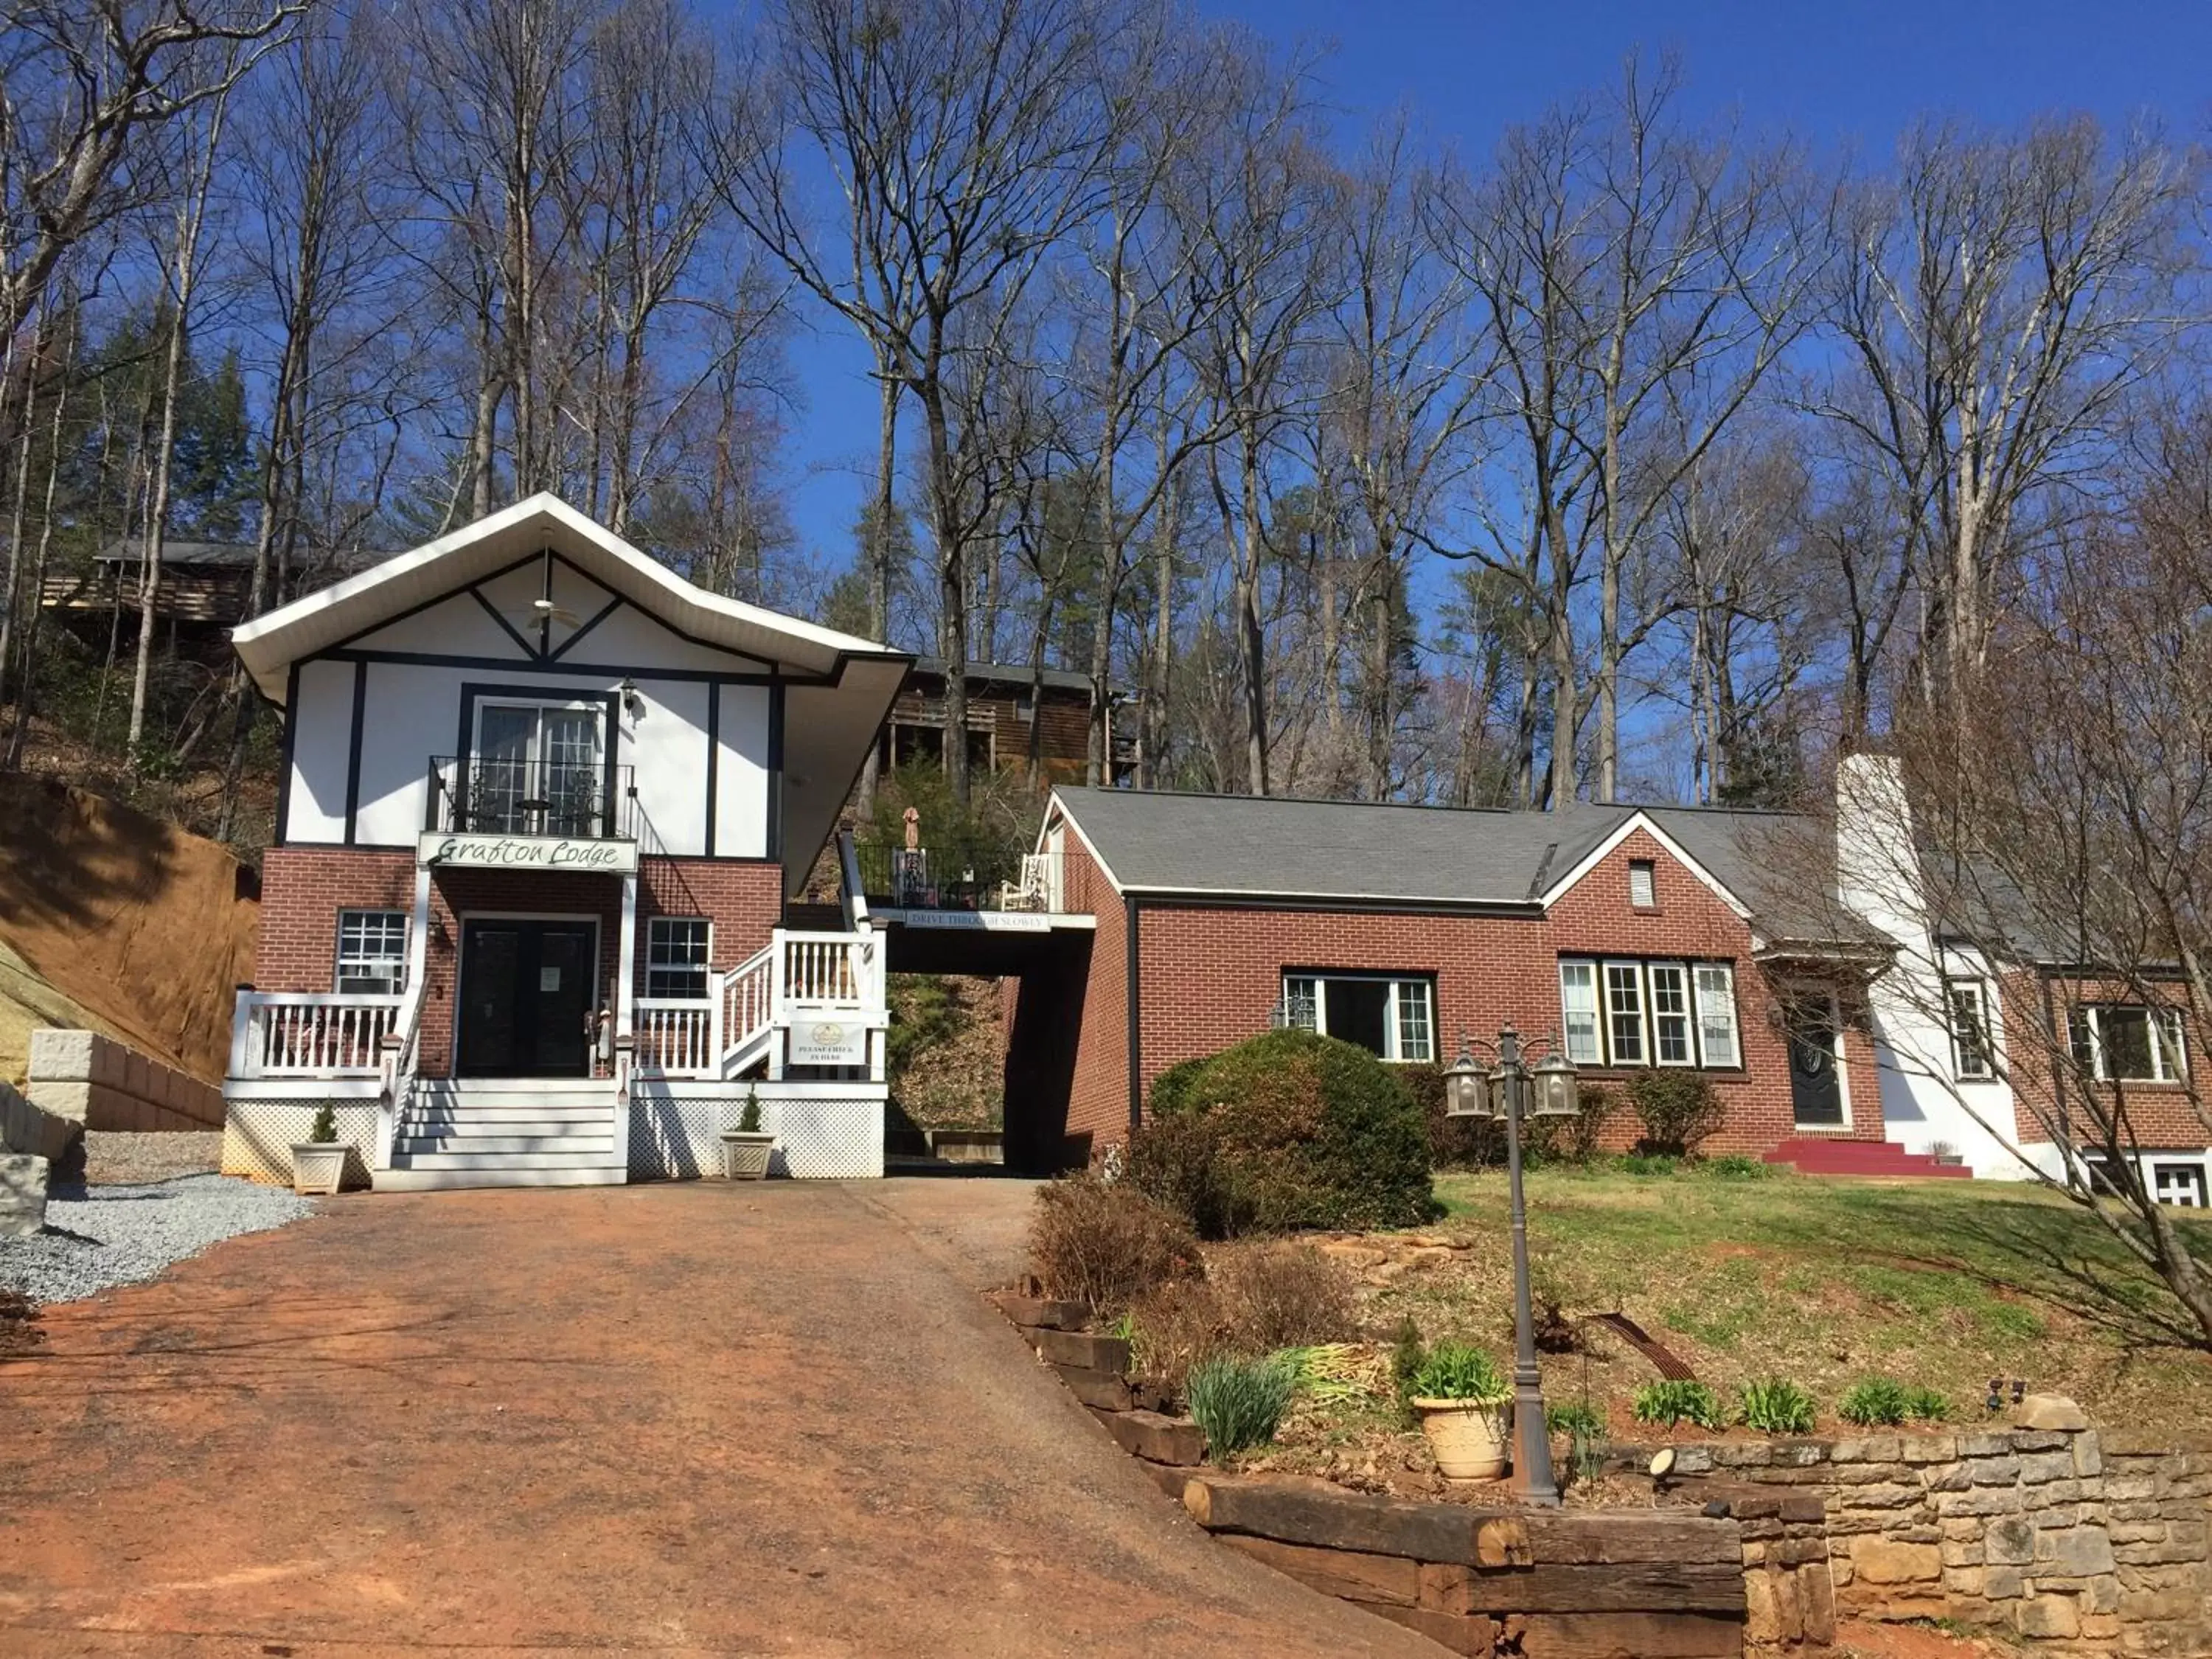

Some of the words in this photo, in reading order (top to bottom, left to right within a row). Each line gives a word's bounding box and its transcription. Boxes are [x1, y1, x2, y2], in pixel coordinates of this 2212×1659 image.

[437, 838, 541, 863] Grafton
[548, 841, 619, 866] Lodge
[911, 913, 943, 922] DRIVE
[1000, 915, 1042, 926] SLOWLY
